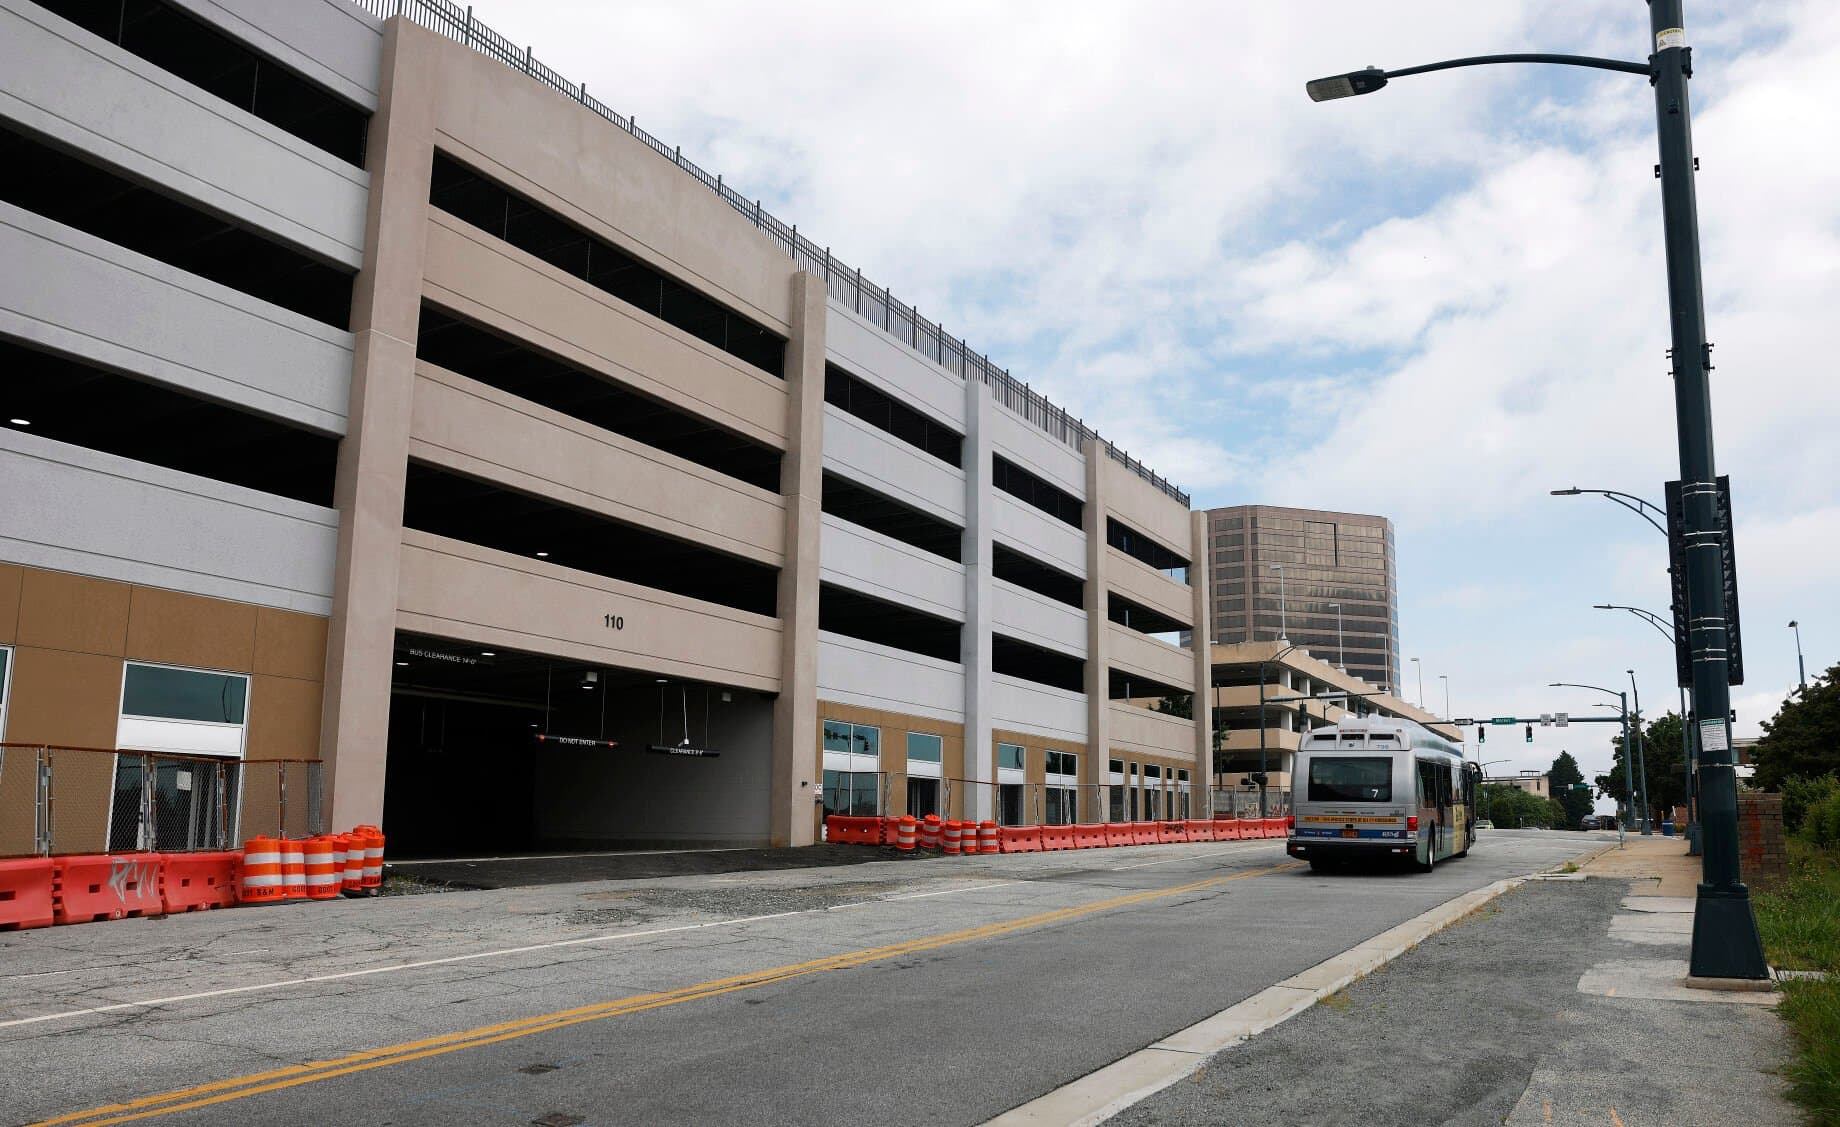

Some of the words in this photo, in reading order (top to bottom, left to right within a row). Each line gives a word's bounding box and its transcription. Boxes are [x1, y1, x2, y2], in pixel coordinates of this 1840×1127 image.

[604, 613, 624, 630] 110
[409, 648, 423, 657] BUS
[424, 650, 461, 663] CLEARANCE
[1371, 788, 1379, 799] 7
